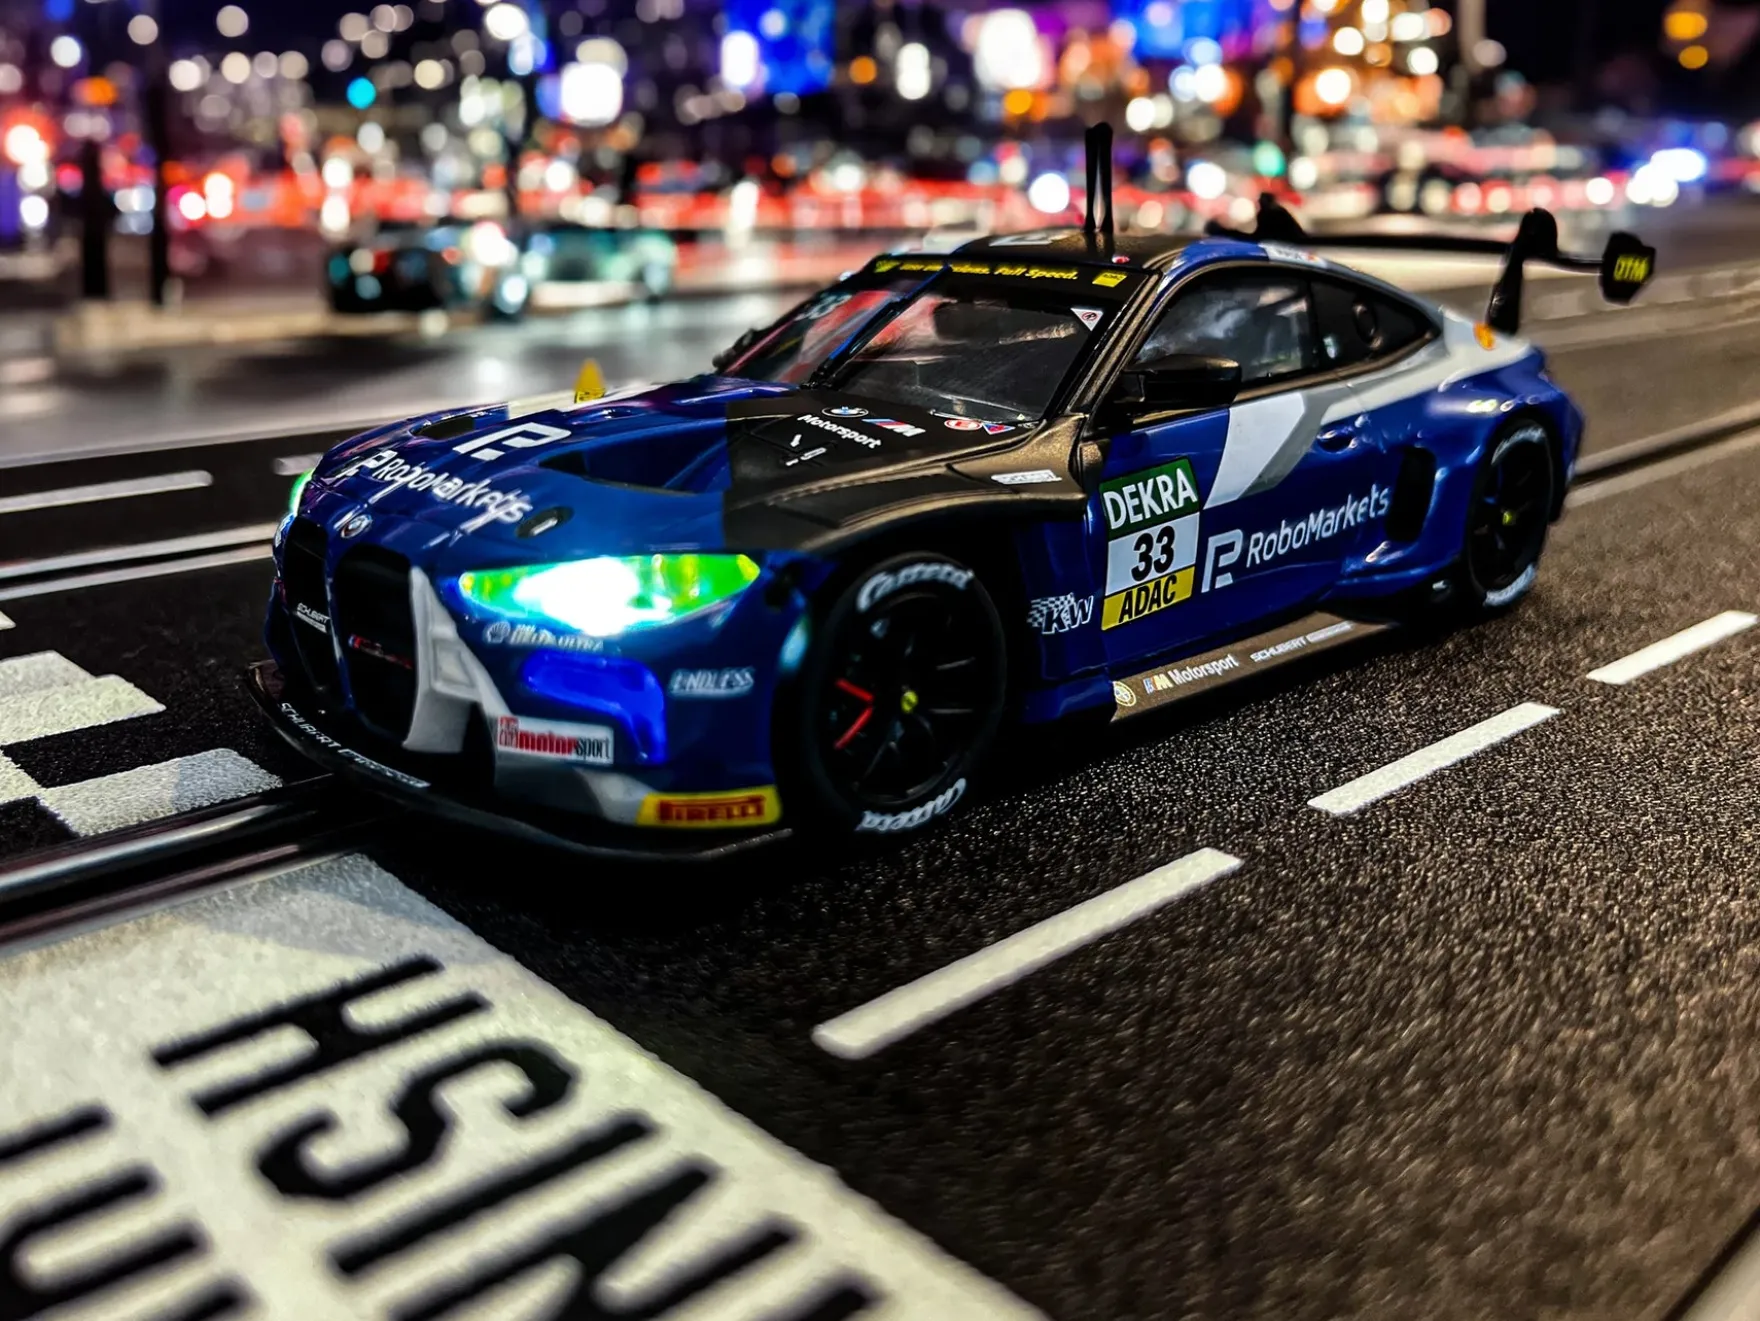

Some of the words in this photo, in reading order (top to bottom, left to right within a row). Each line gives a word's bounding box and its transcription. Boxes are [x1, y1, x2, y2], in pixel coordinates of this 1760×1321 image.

[797, 413, 882, 449] Motorsport
[1102, 467, 1199, 530] DEKRA
[1246, 483, 1390, 568] RoboMarkets
[1131, 525, 1176, 582] 33
[1118, 575, 1177, 623] ADAC
[1250, 635, 1308, 664] SCHUBERT
[671, 667, 755, 695] ENDLESS
[1170, 653, 1239, 685] Motorsport
[657, 795, 766, 822] PIRELLI
